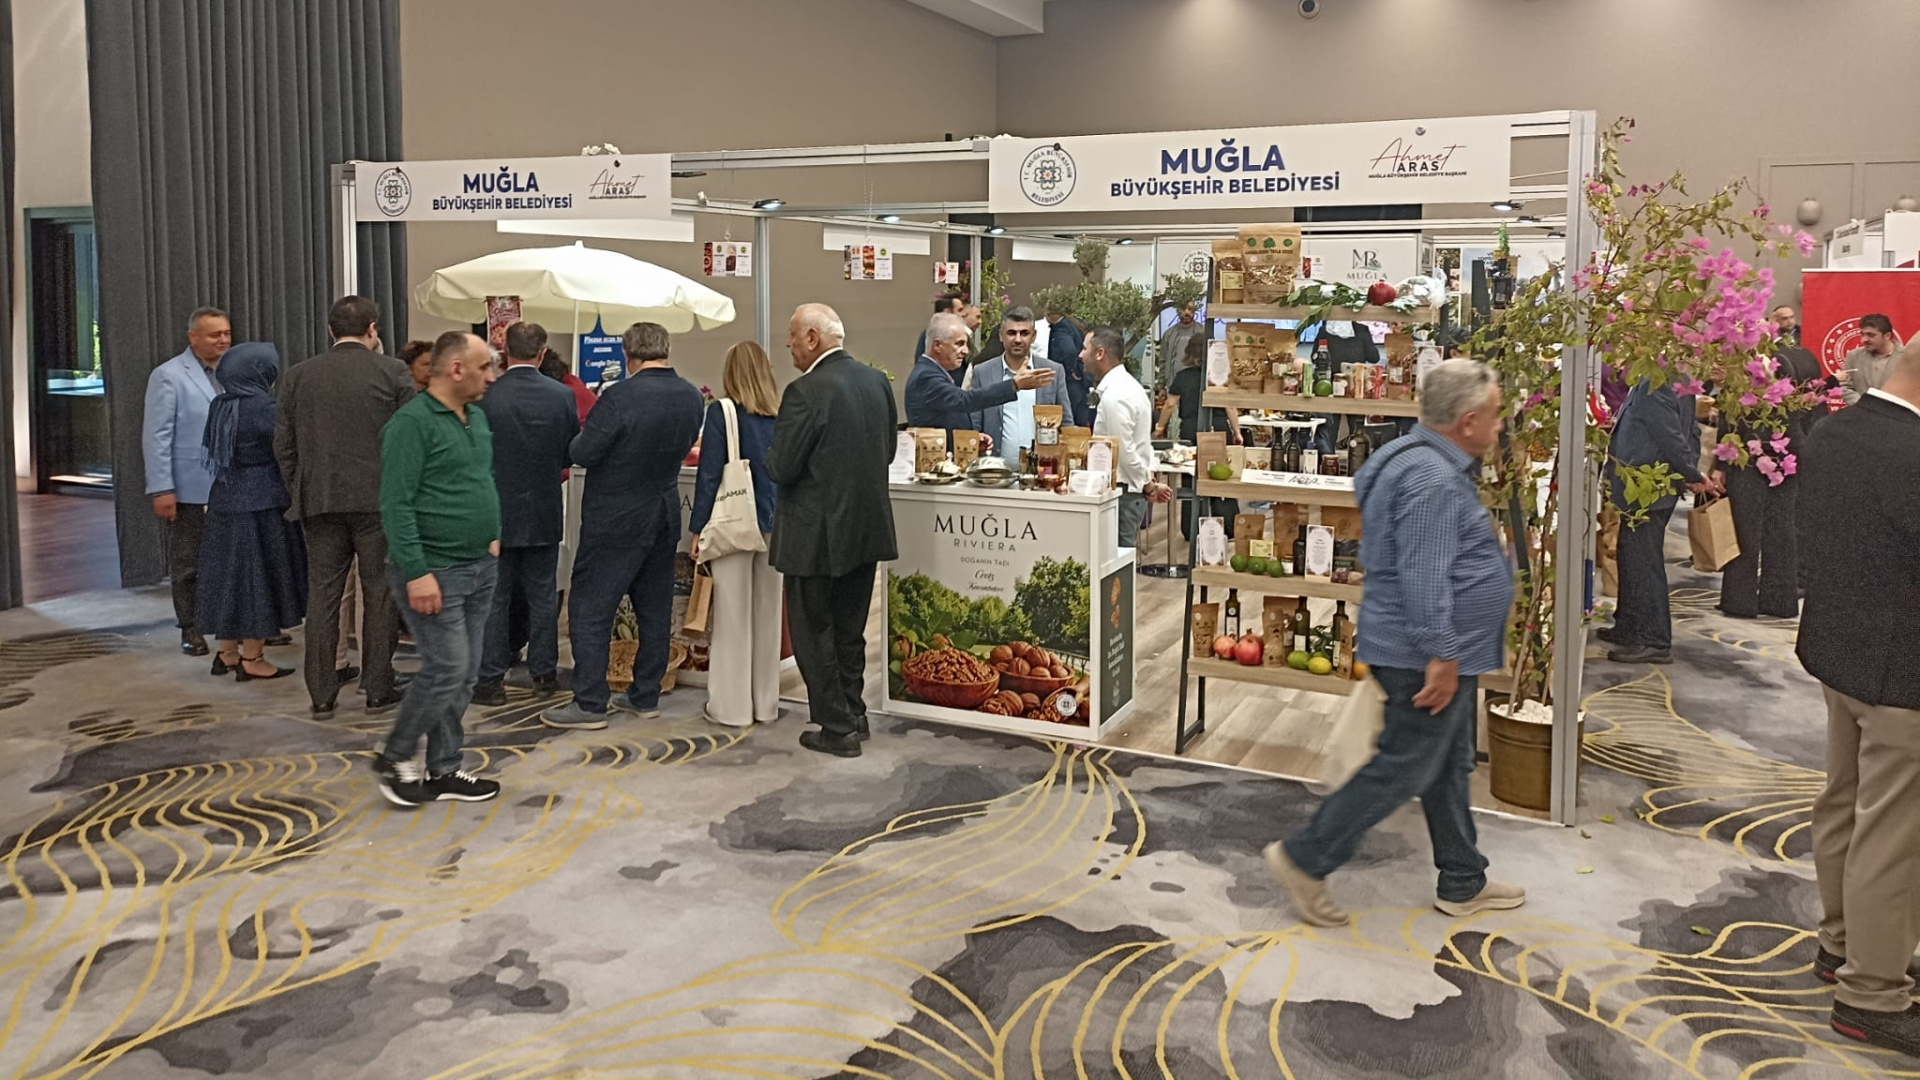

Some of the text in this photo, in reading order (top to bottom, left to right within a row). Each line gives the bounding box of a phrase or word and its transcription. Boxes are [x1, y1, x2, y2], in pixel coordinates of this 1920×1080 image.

[1161, 138, 1285, 175] MUĞLA
[1370, 137, 1467, 172] Ahmet
[1397, 160, 1439, 172] ARAS
[463, 166, 540, 193] MUĞLA
[1110, 171, 1340, 200] BÜYÜKŞEHİR BELEDİYESİ
[605, 187, 631, 195] ARAS
[432, 193, 573, 213] BÜYÜKŞEHİR BELEDİYESİ
[1346, 270, 1388, 280] MUĞLA
[934, 512, 1038, 541] MUĞLA
[953, 537, 1016, 552] RIVIERA
[960, 556, 992, 565] DOĞANIN
